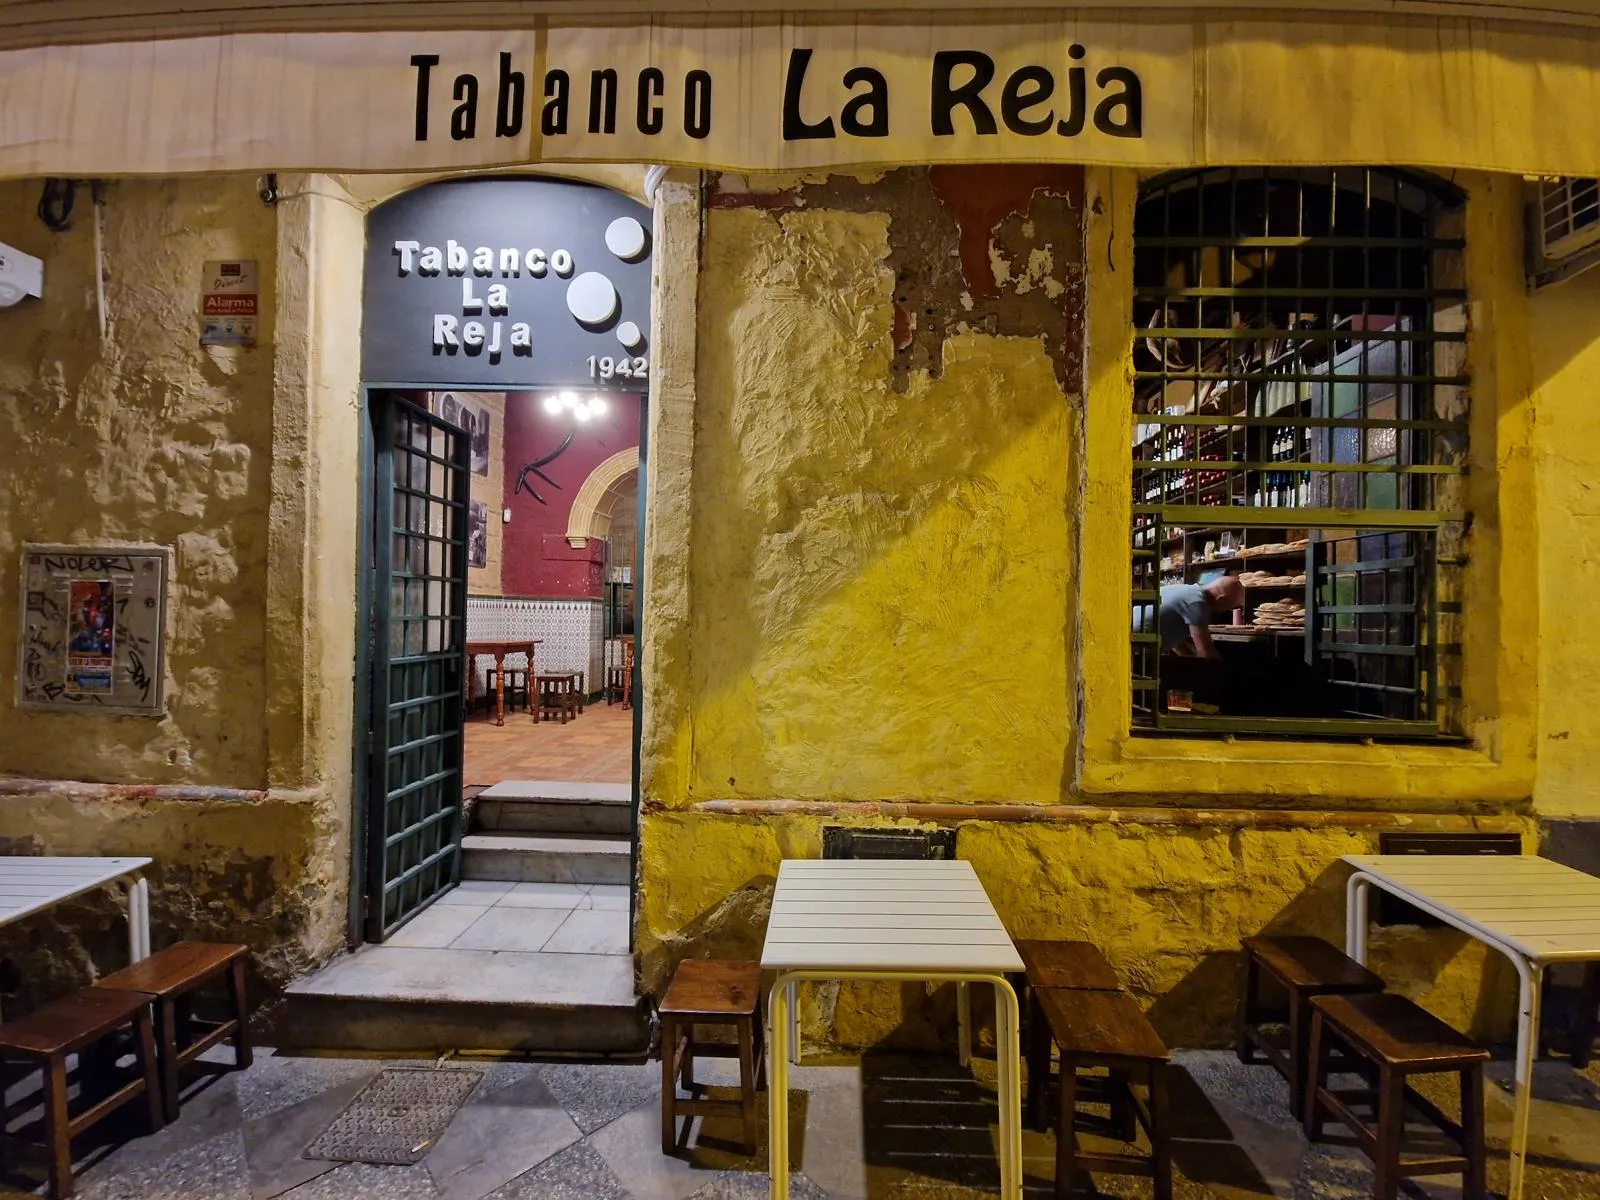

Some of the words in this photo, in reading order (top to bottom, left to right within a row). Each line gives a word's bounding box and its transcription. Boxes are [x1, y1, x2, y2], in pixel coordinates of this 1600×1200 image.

[410, 51, 712, 141] Tabanco
[783, 48, 889, 140] La
[931, 43, 1142, 137] Reja
[395, 240, 573, 274] Tabanco
[207, 296, 254, 307] Alarma
[462, 277, 509, 309] La
[433, 314, 532, 354] Reja
[586, 355, 648, 379] 1942
